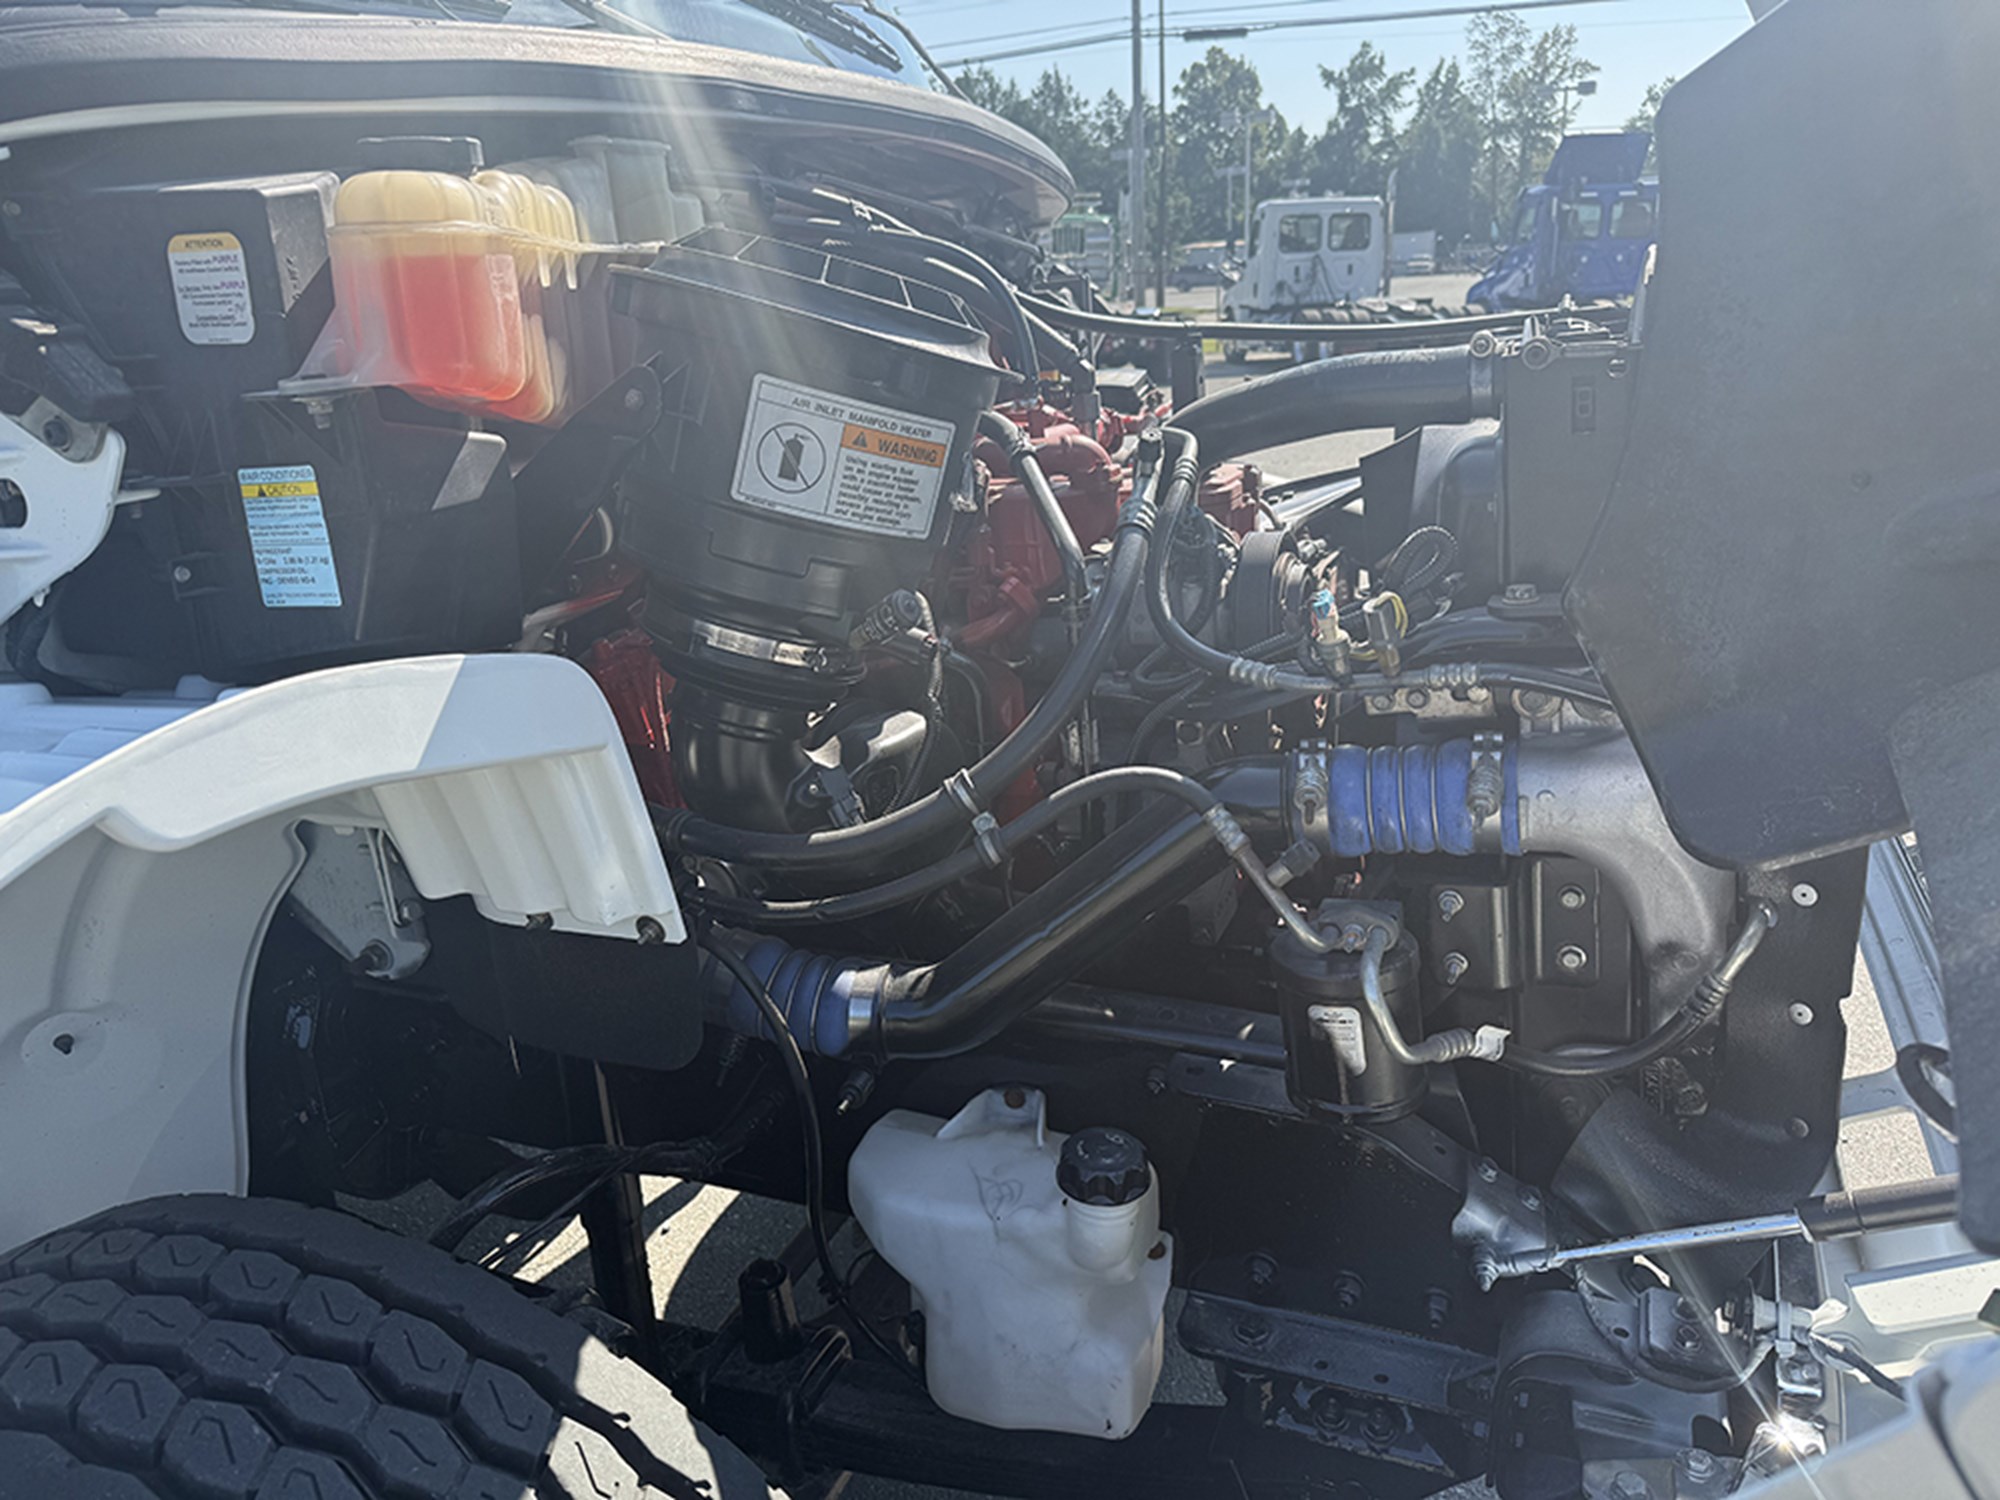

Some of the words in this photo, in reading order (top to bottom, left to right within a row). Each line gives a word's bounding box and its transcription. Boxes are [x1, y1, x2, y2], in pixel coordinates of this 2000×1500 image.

[185, 238, 223, 248] ATTENTION
[792, 397, 812, 410] AIR
[814, 403, 845, 418] INLET
[849, 411, 898, 431] MANIFOLD
[900, 424, 932, 439] HEATER
[878, 439, 939, 463] WARNING
[267, 485, 301, 495] CAUTION
